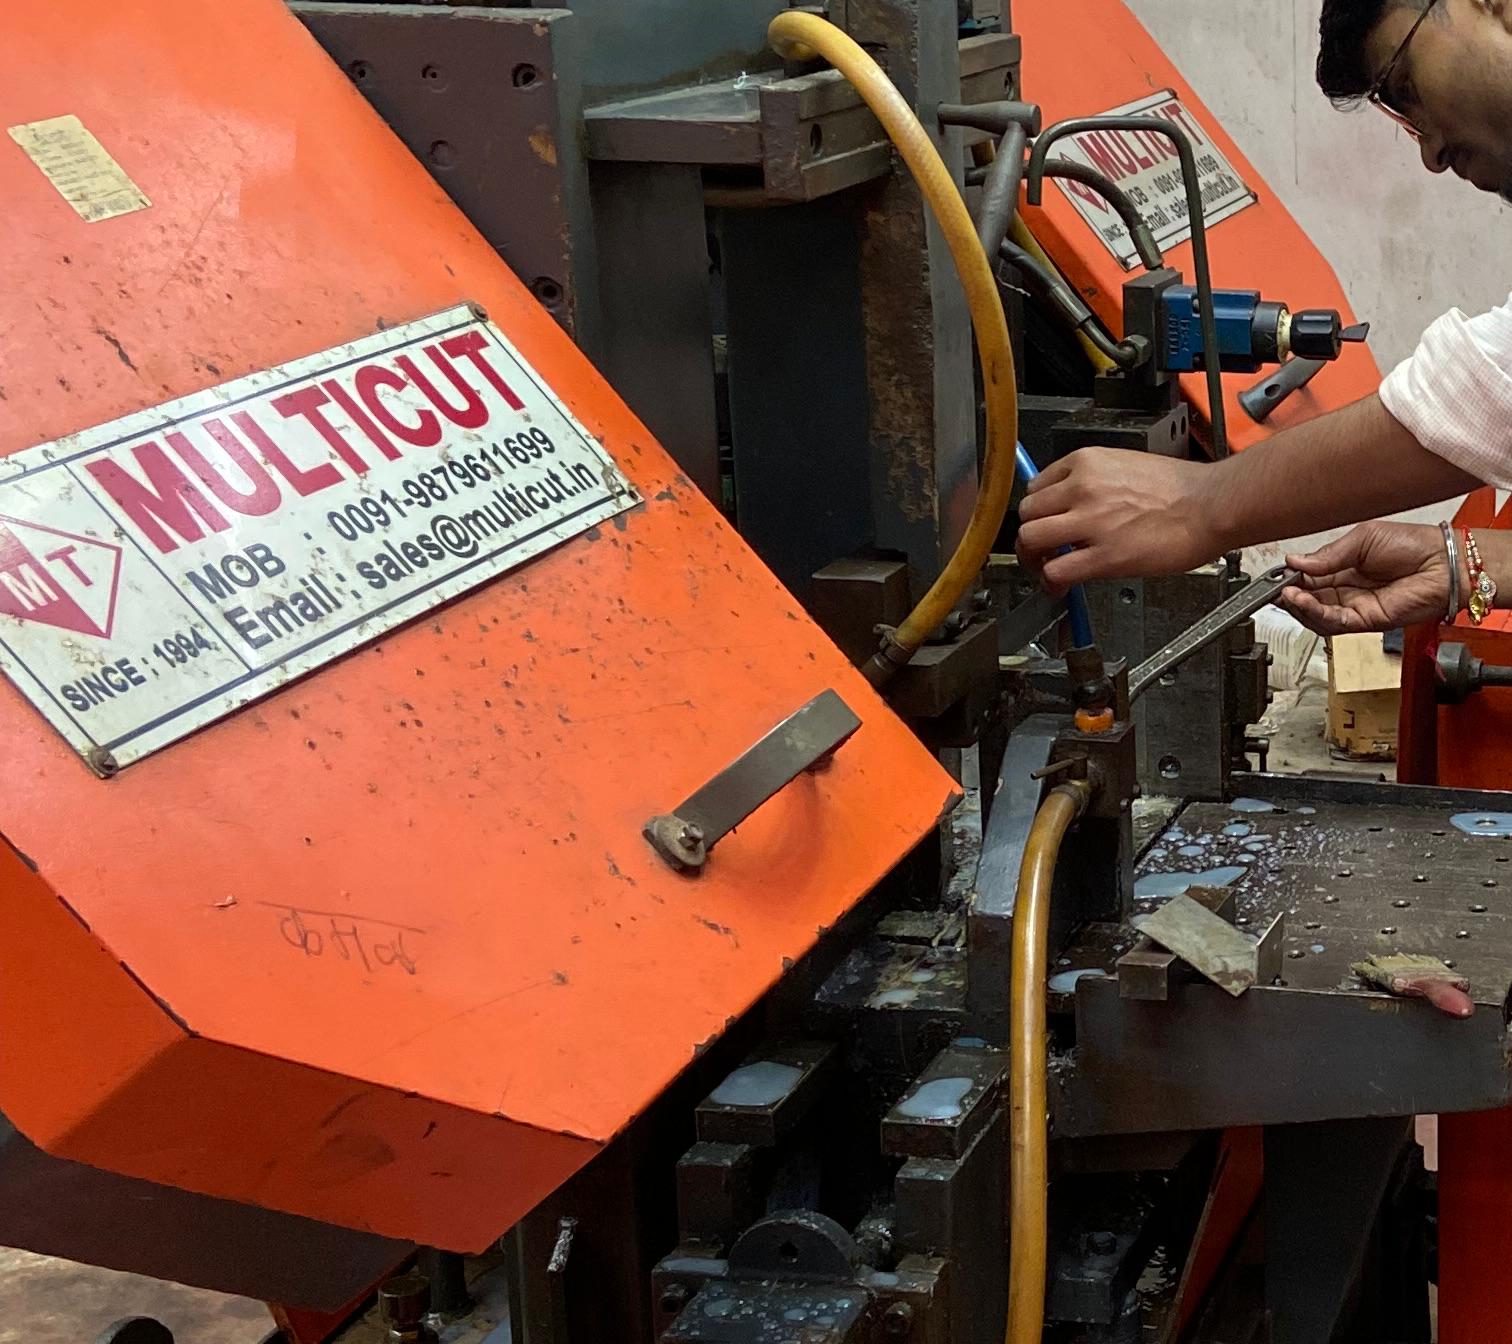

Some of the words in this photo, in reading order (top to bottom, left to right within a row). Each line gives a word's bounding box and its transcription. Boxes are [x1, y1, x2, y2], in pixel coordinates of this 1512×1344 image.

[84, 330, 526, 554] MULTICUT
[185, 543, 286, 604] MOB
[327, 427, 556, 542] 0091-9879611699
[223, 573, 342, 649] Email
[356, 460, 601, 590] sales@multicut.in
[60, 657, 146, 712] SINCE
[152, 626, 213, 669] 1994
